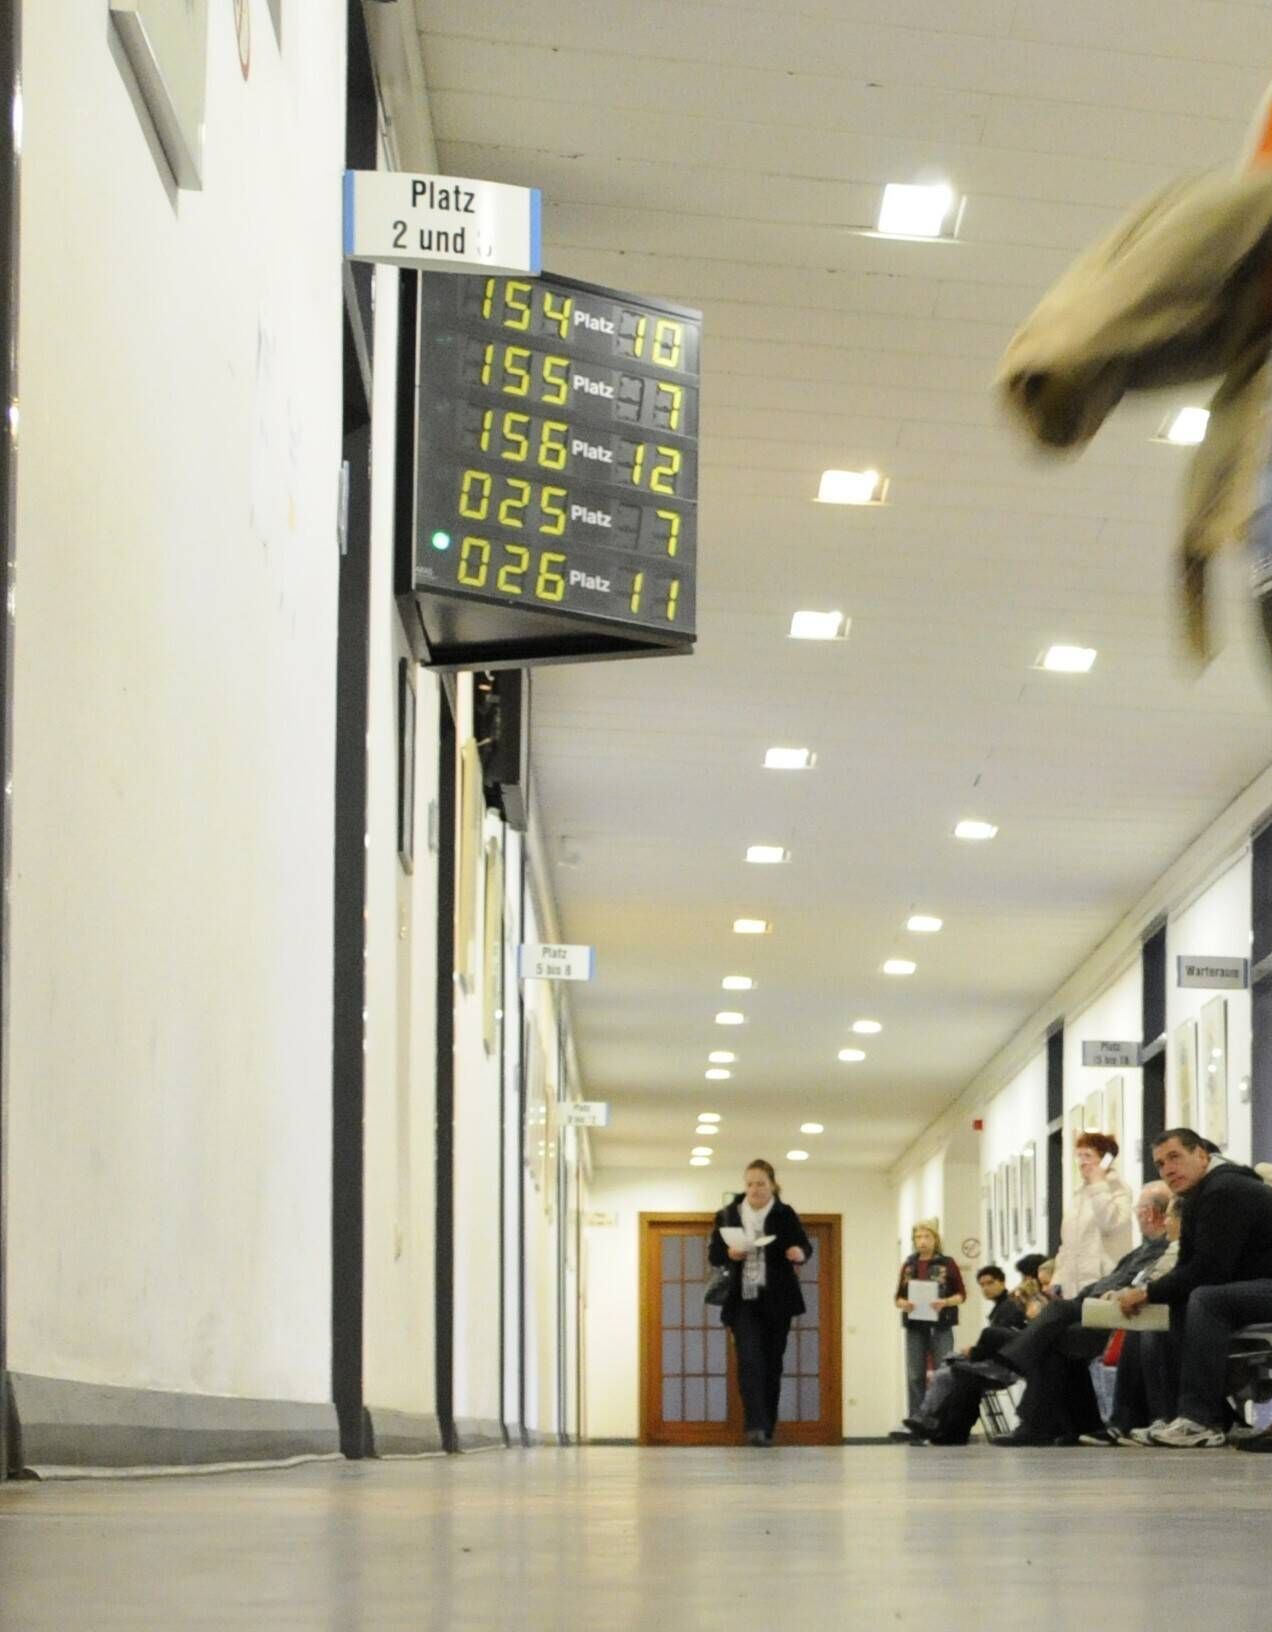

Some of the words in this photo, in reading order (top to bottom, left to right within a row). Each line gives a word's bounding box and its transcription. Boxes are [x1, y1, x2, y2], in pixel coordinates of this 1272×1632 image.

[392, 220, 407, 249] 2
[419, 226, 465, 254] und
[411, 180, 475, 213] Platz
[481, 278, 572, 338] 154
[574, 309, 615, 335] Platz
[632, 316, 682, 368] 10
[480, 344, 570, 406] 155
[573, 374, 615, 400] Platz
[655, 384, 683, 431] 7
[480, 410, 569, 471] 156
[572, 438, 613, 464] Platz
[631, 441, 682, 494] 12
[459, 470, 568, 536] 025
[571, 503, 612, 529] Platz
[655, 509, 681, 558] 7
[457, 536, 567, 602] 026
[569, 567, 611, 593] Platz
[630, 572, 680, 621] 11
[542, 946, 567, 959] Platz
[1185, 965, 1240, 979] Warteraum
